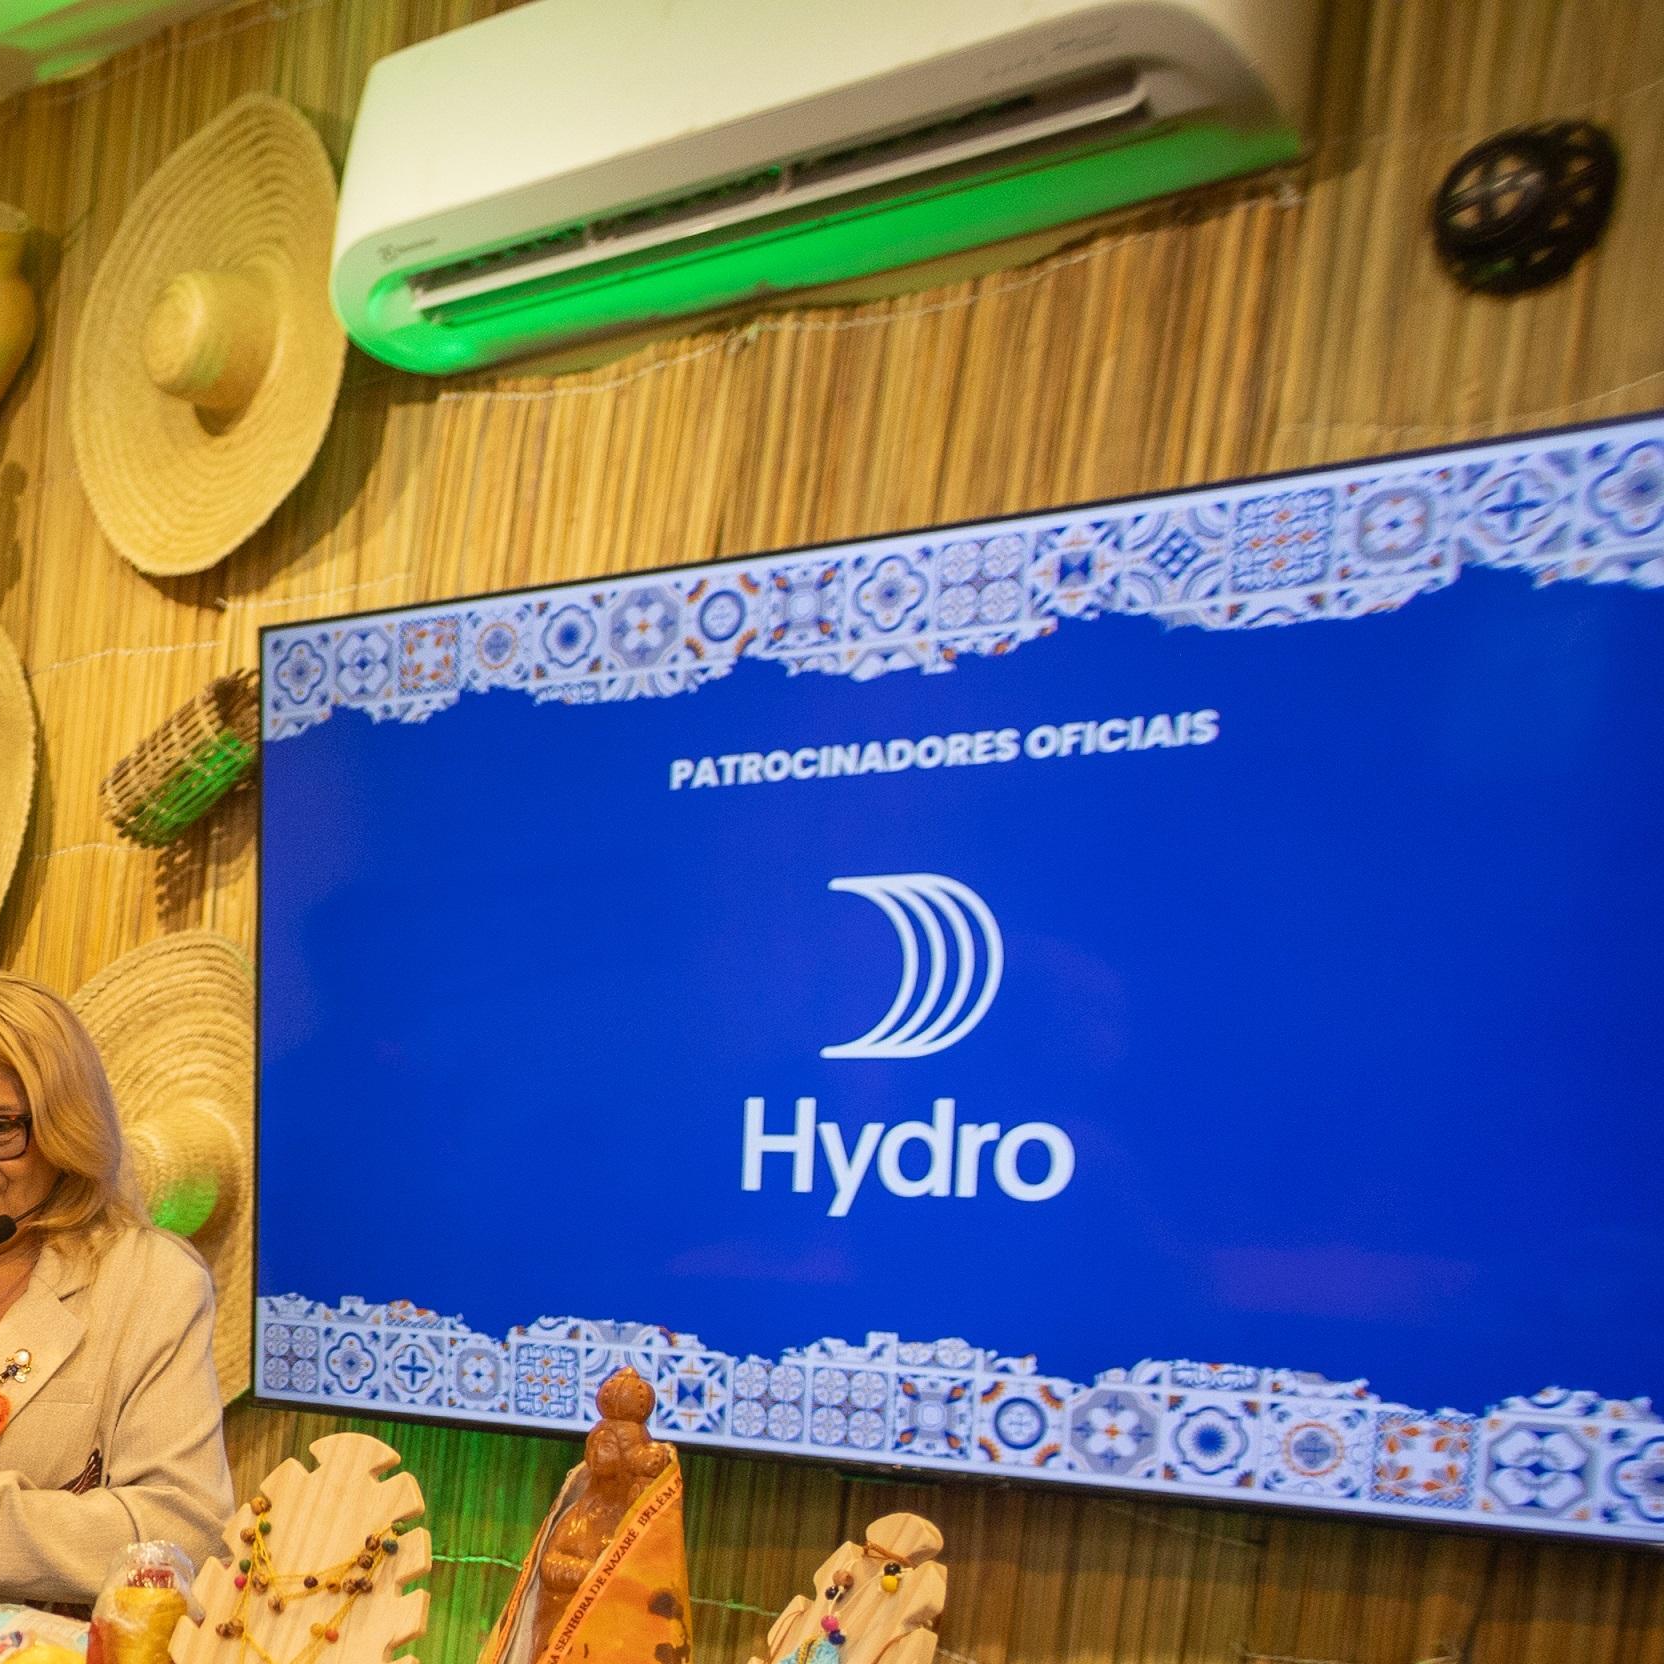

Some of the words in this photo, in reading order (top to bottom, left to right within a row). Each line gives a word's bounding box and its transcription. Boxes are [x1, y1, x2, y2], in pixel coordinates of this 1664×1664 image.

[668, 727, 1021, 790] PATROCINADORES
[1023, 708, 1220, 759] OFICIAIS
[741, 1095, 1076, 1218] Hydro
[554, 1595, 594, 1652] SENHORA
[589, 1575, 607, 1595] DE
[603, 1528, 639, 1576] NAZARÉ
